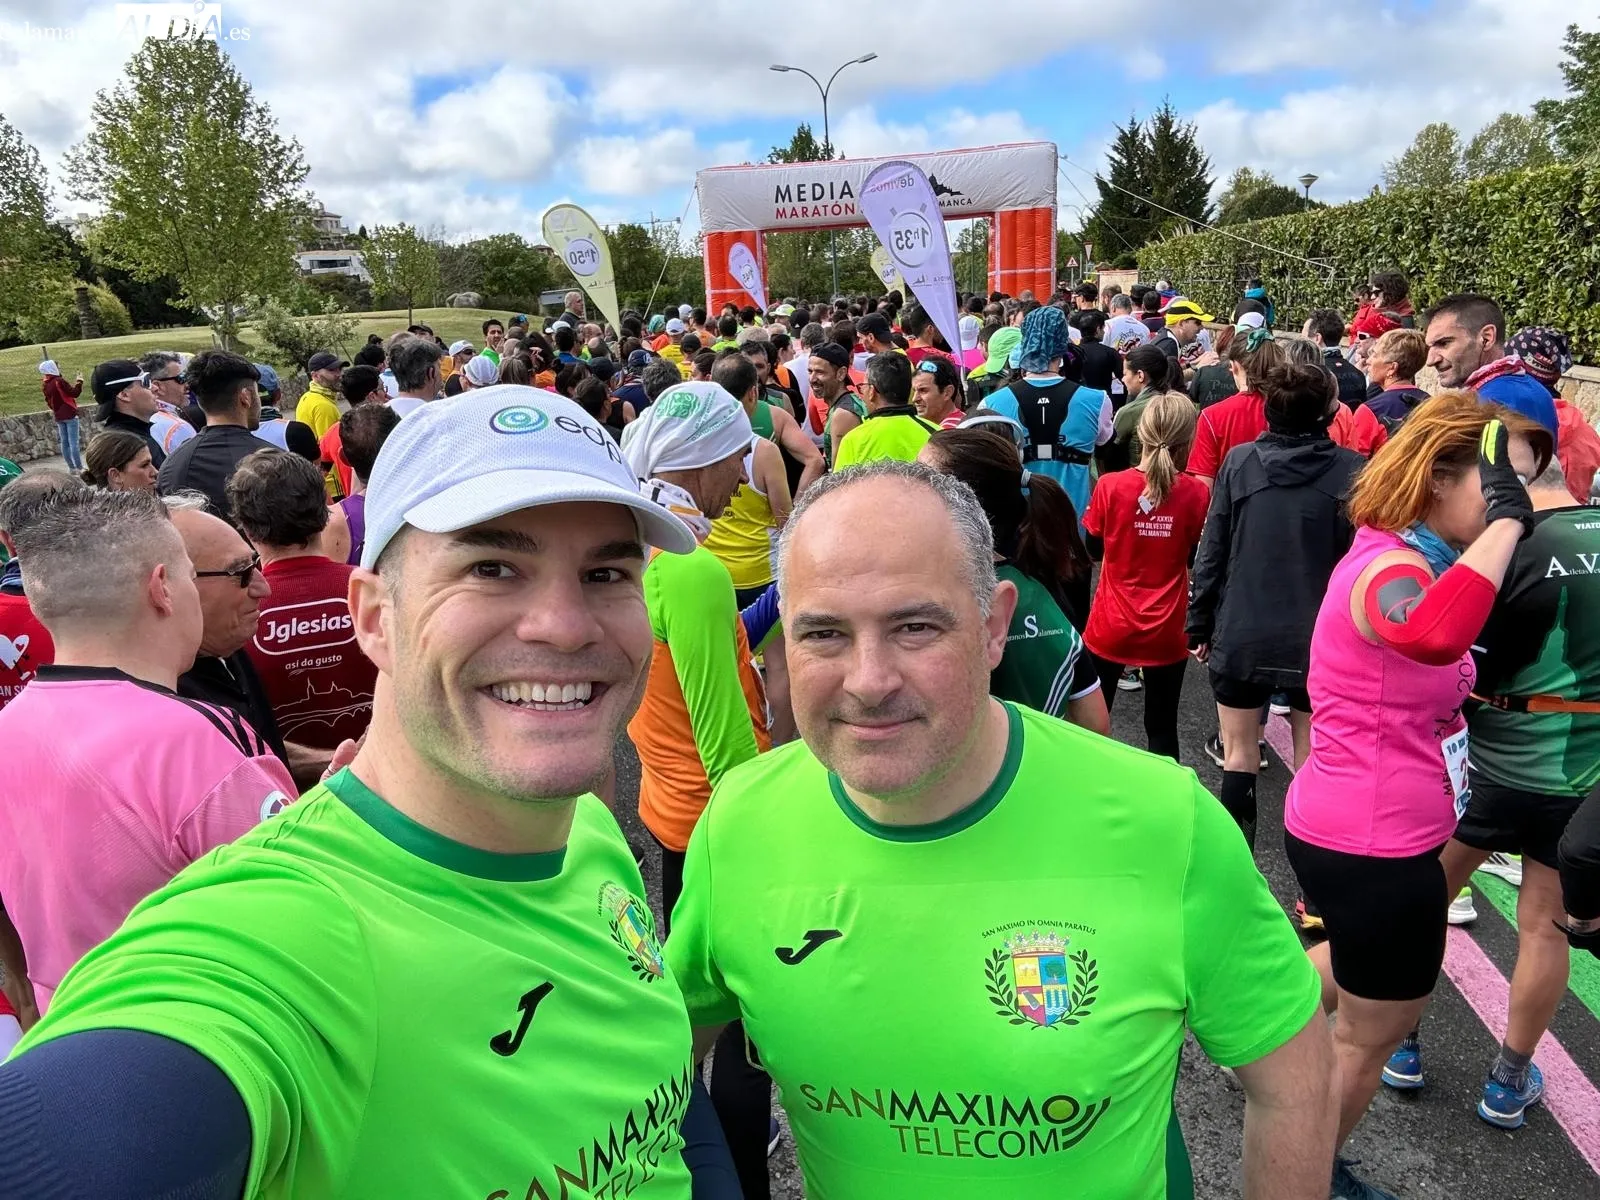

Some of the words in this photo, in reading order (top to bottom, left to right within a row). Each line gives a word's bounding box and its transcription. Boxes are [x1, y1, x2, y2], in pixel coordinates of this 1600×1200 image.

[774, 180, 854, 204] MEDIA
[775, 203, 855, 220] MARATÓN
[939, 198, 973, 208] MANCA
[1134, 521, 1145, 529] SAN
[301, 658, 313, 667] da
[315, 655, 342, 667] gusto
[981, 928, 996, 939] SAN
[996, 920, 1026, 932] MAXIMO
[1037, 919, 1064, 928] OMNIA
[1064, 921, 1097, 936] PARATUS
[889, 1122, 1060, 1160] TELECOM
